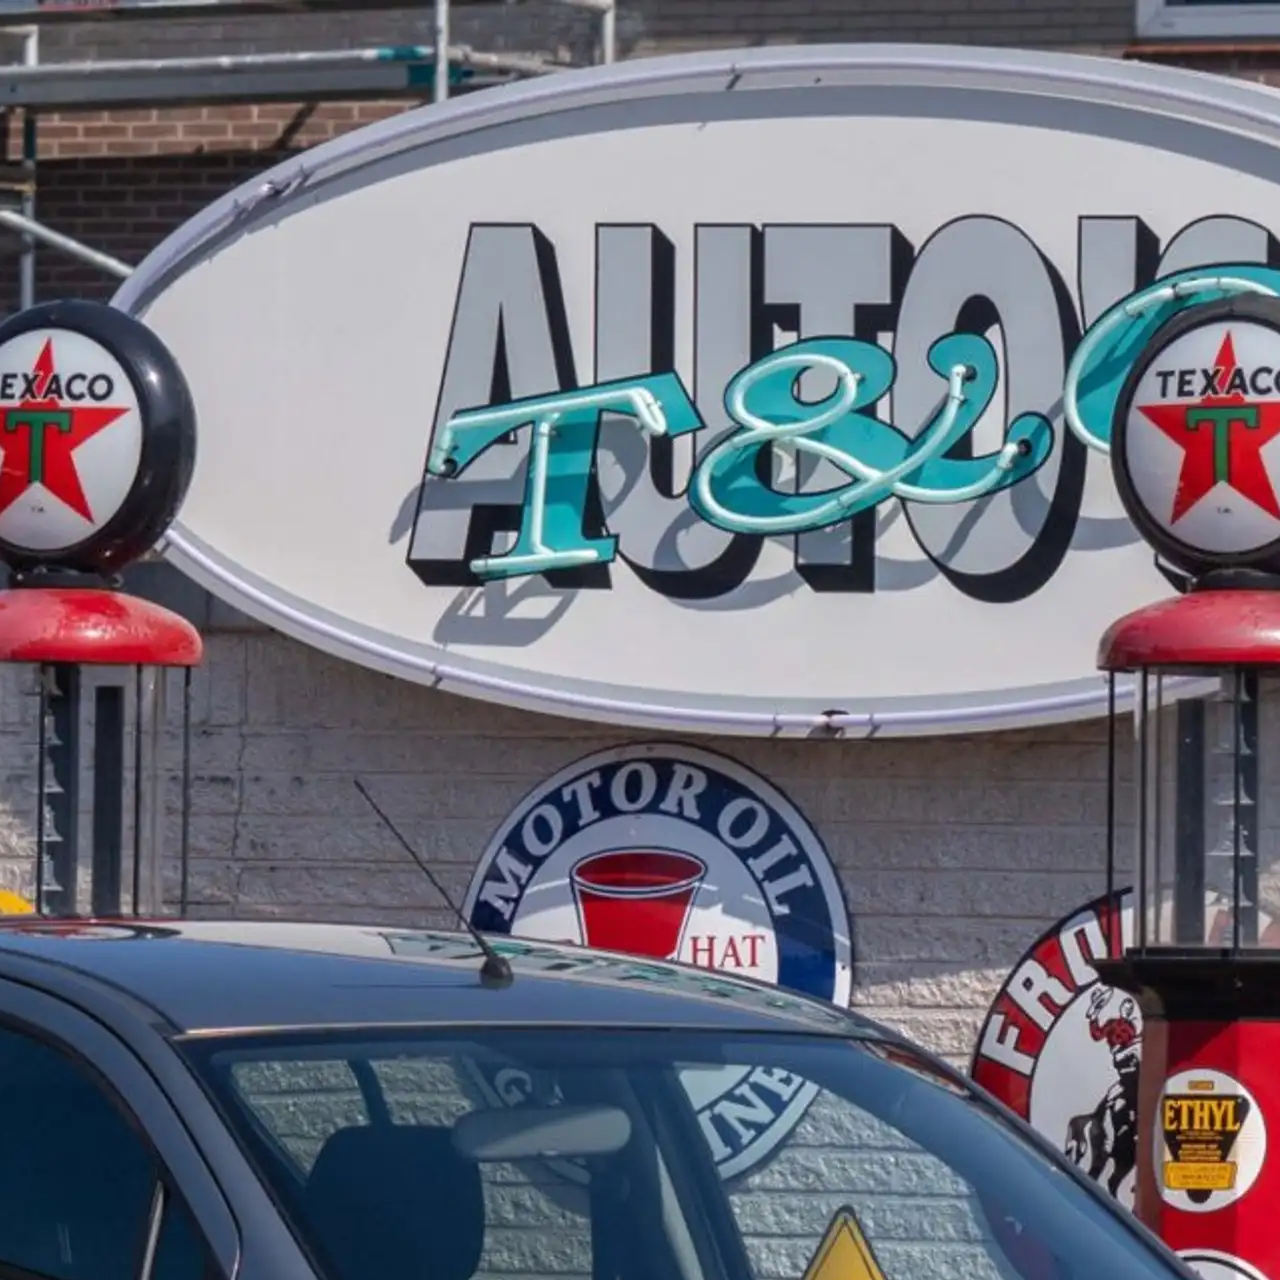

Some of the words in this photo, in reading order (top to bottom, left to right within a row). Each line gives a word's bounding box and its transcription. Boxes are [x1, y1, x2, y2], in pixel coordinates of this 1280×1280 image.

[6, 411, 73, 485] T
[1186, 405, 1260, 485] T
[479, 761, 708, 921] MOTOR
[717, 796, 815, 917] OIL
[690, 934, 766, 970] HAT
[979, 897, 1135, 1077] FRO
[1164, 1099, 1241, 1131] ETHYL
